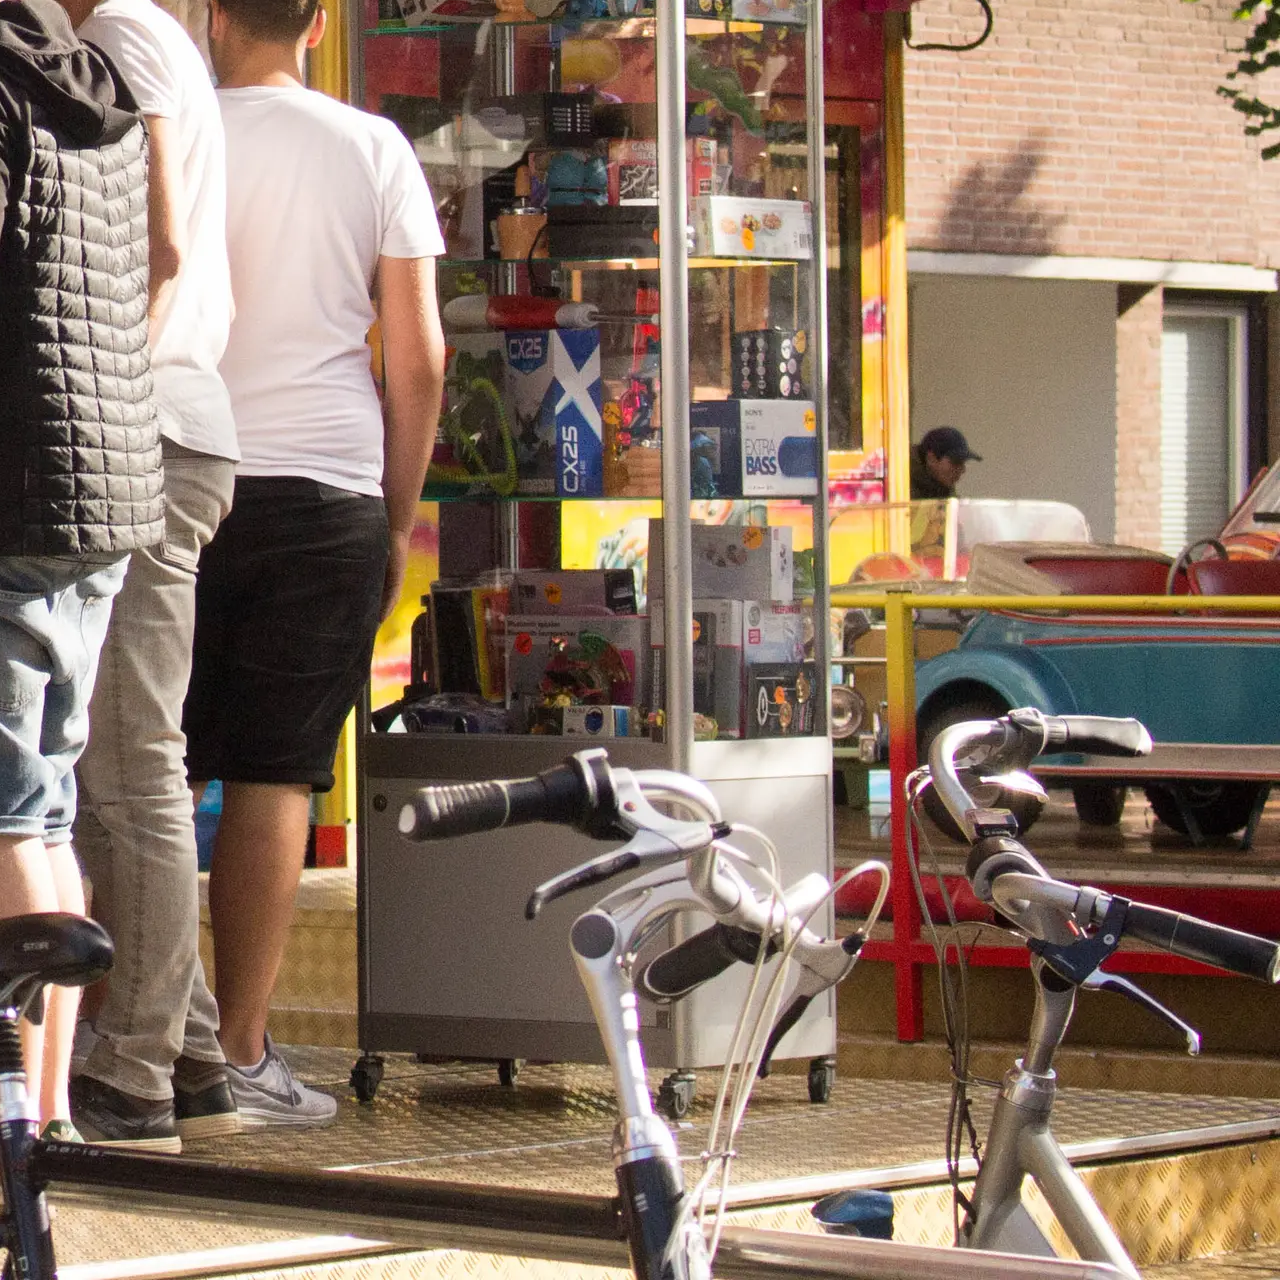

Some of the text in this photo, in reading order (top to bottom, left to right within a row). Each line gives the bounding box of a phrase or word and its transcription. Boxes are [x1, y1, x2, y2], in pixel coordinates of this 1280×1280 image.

[509, 338, 542, 360] CX25
[744, 439, 776, 456] EXTRA
[562, 425, 578, 493] CX25
[745, 456, 777, 476] BASS
